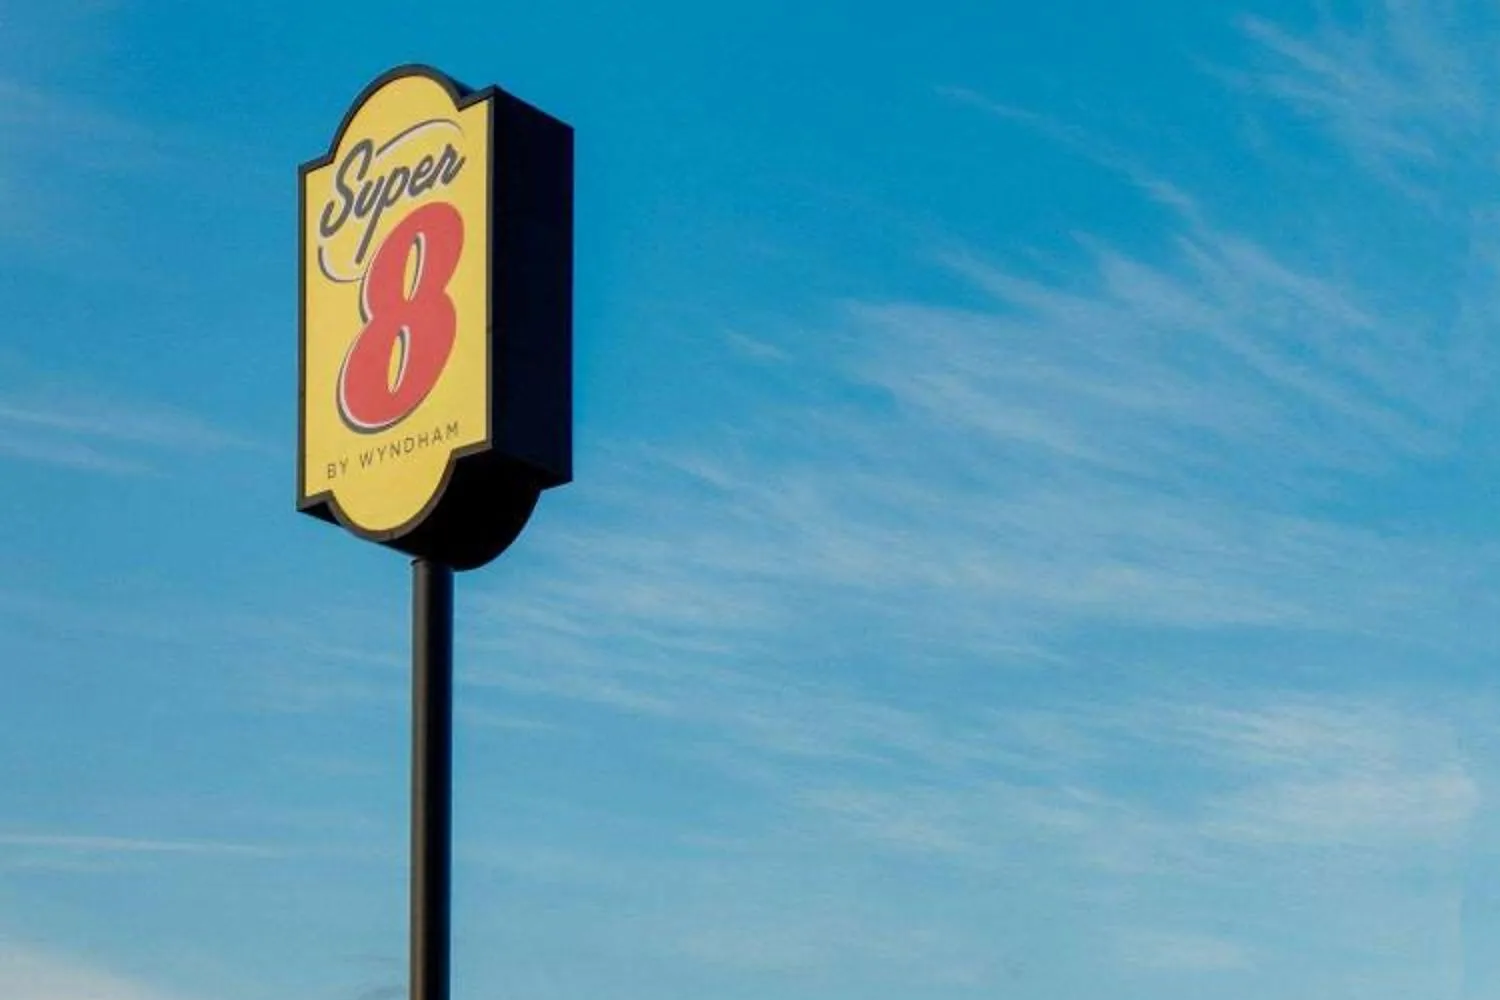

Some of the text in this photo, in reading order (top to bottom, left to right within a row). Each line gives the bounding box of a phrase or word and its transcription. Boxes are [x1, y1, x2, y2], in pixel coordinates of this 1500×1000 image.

[319, 138, 466, 266] Super
[336, 201, 465, 435] 8
[327, 421, 459, 479] BY WYNDHAM
